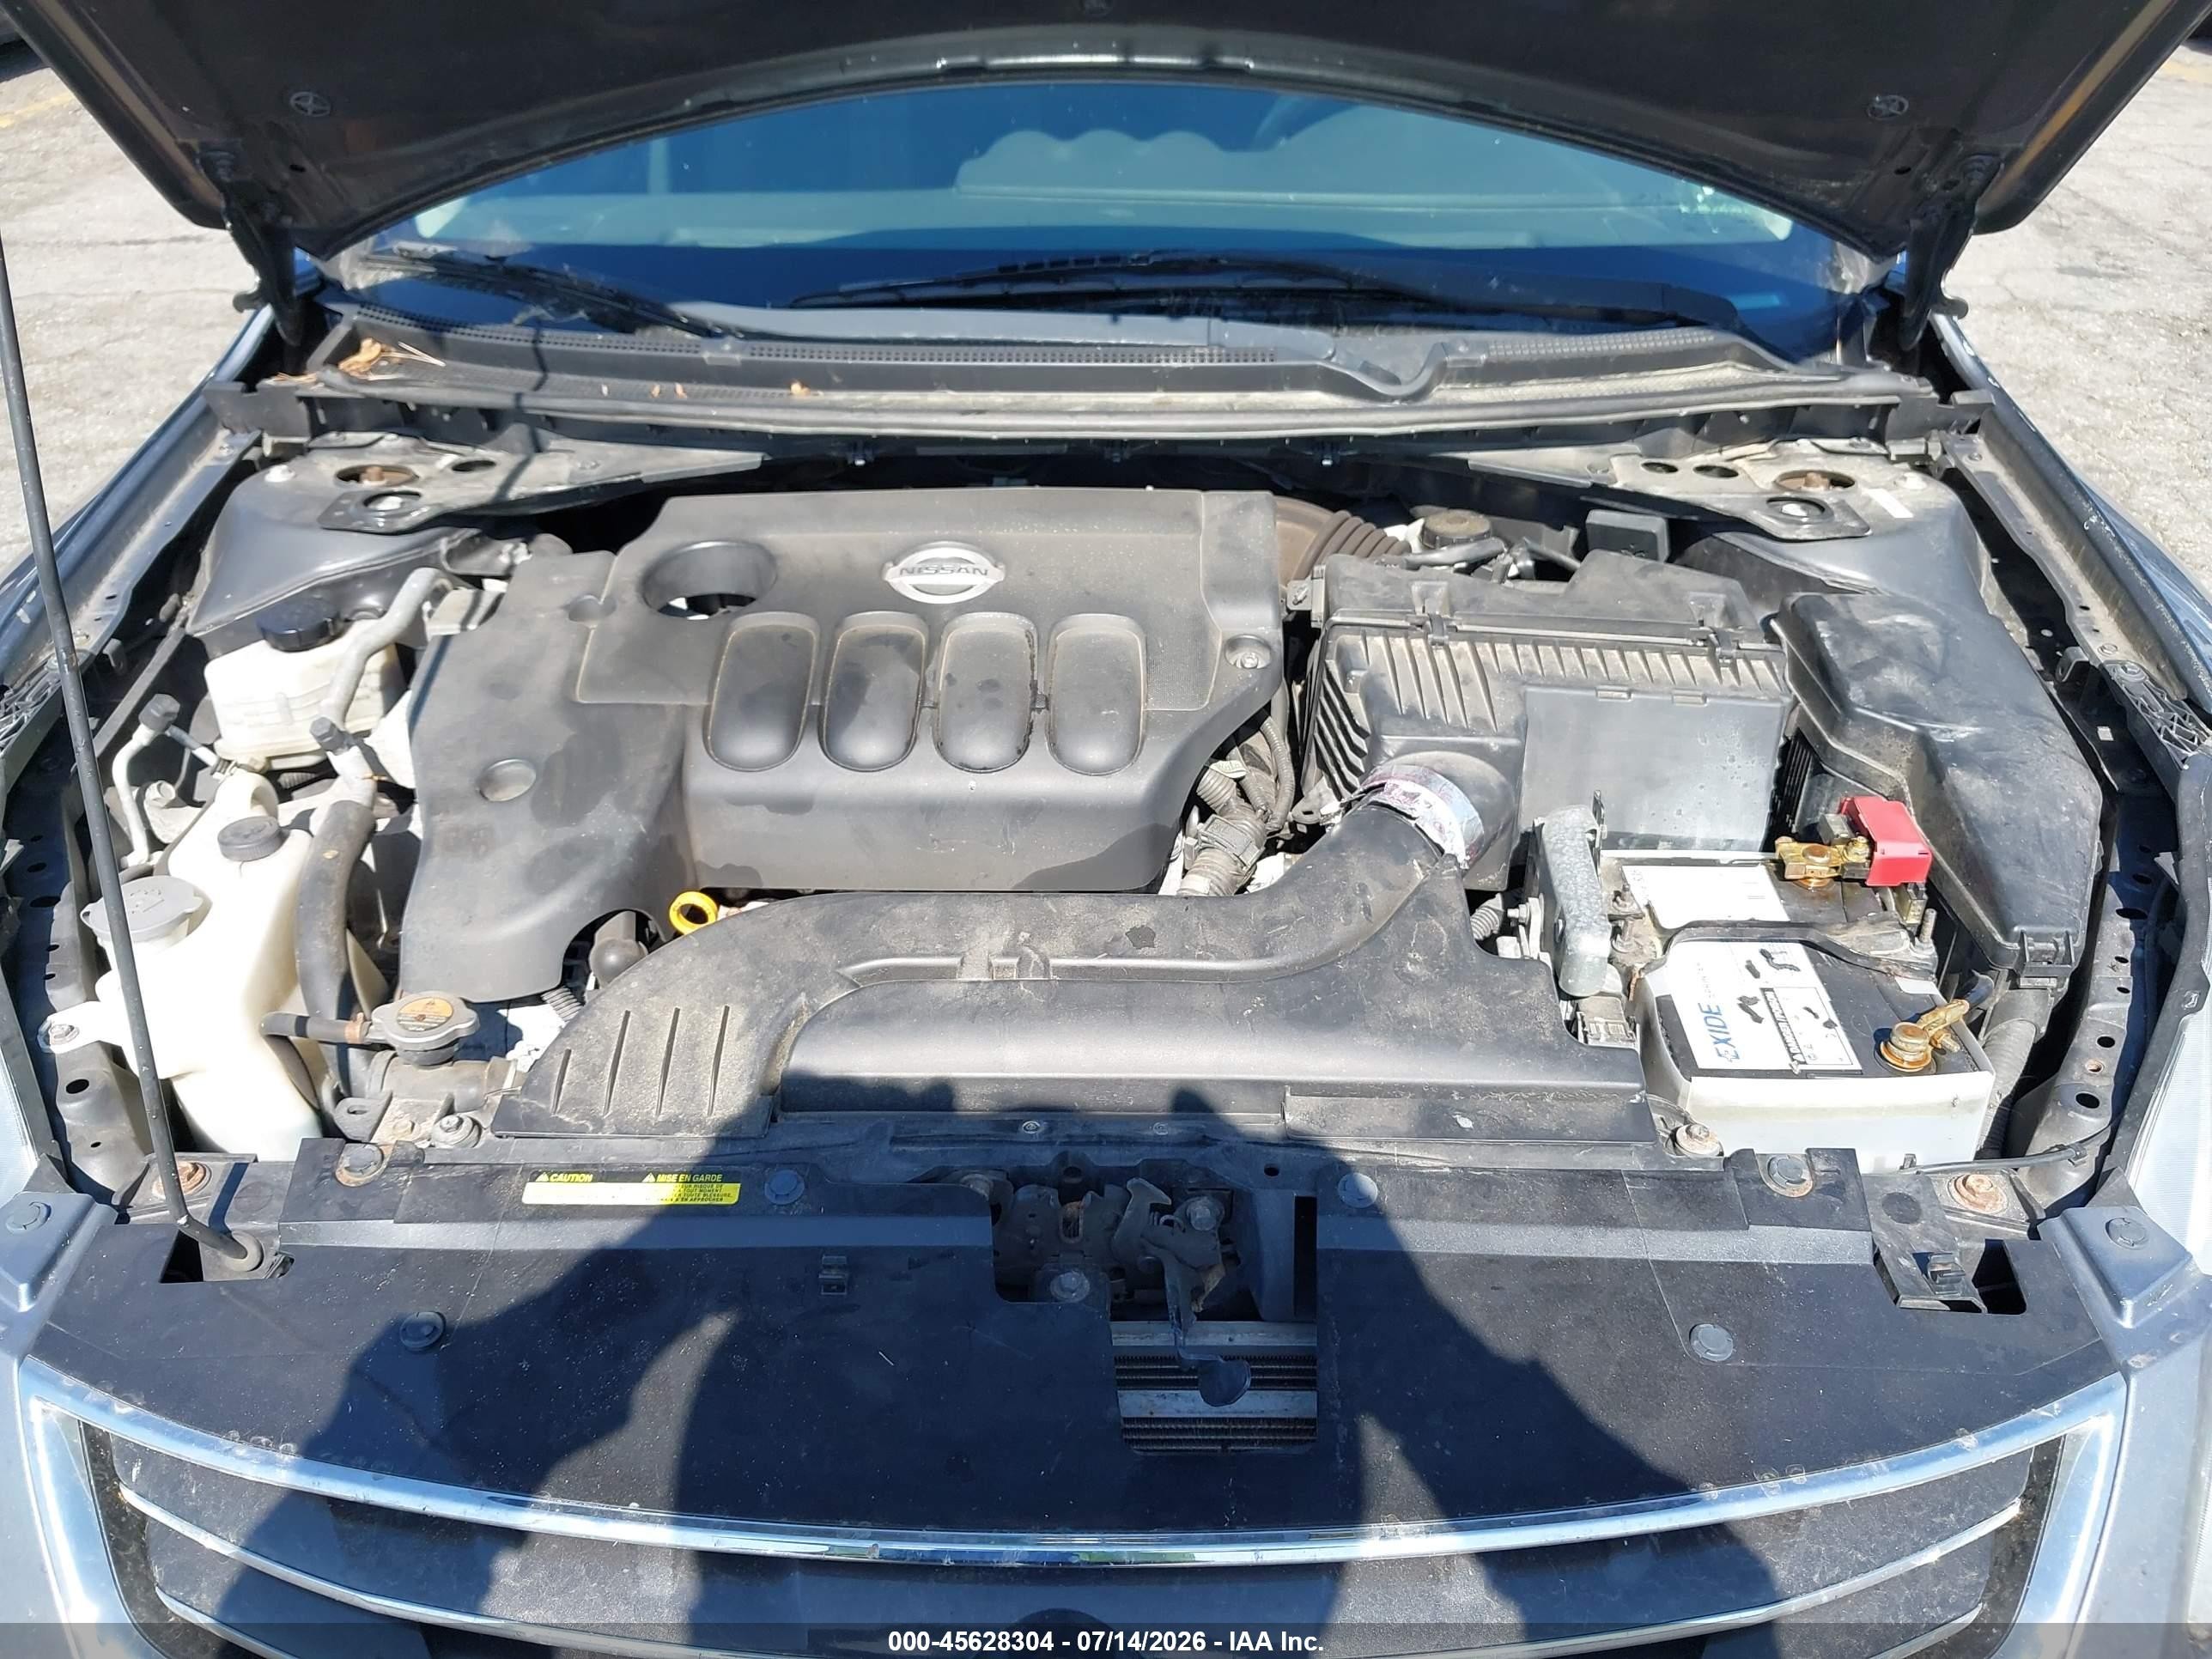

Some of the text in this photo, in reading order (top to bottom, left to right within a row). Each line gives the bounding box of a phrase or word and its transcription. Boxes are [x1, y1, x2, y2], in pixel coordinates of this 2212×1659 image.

[899, 566, 988, 576] NISSAN
[1698, 1002, 1740, 1062] EXIDE
[550, 1174, 593, 1182] CAUTION
[656, 1174, 723, 1182] MISE EN GARDE
